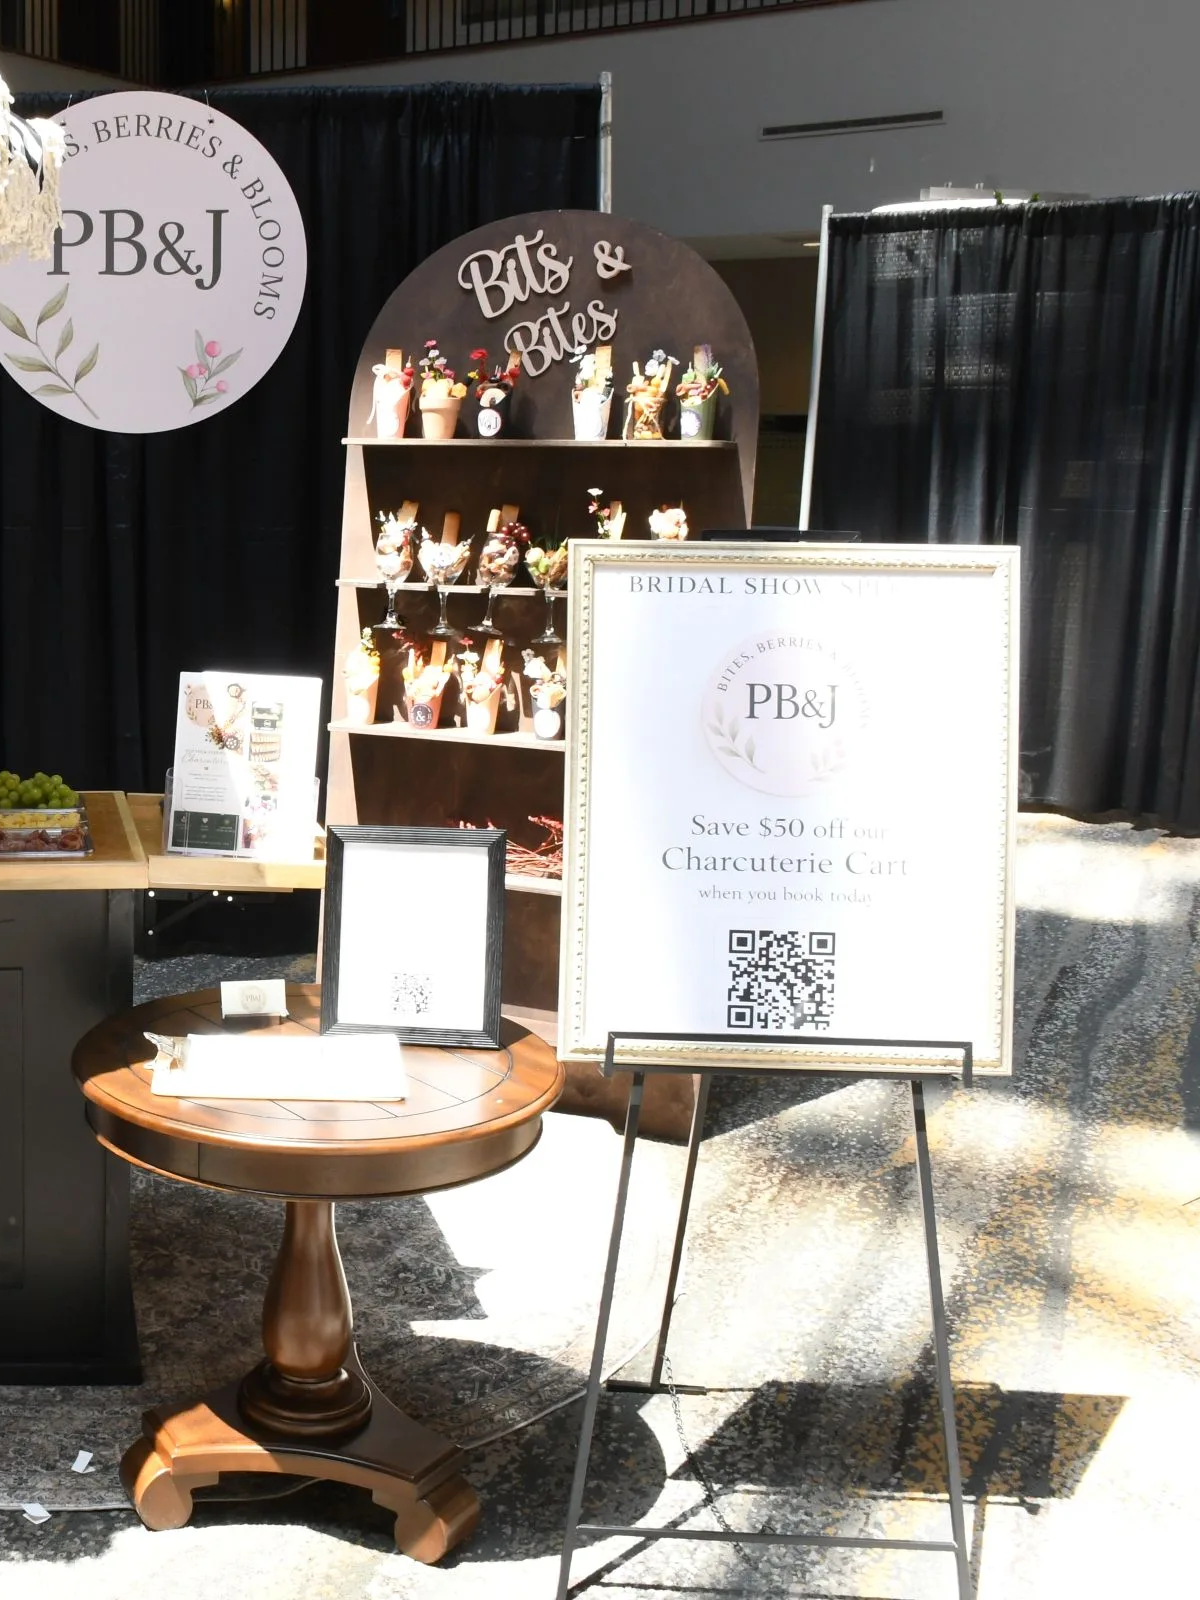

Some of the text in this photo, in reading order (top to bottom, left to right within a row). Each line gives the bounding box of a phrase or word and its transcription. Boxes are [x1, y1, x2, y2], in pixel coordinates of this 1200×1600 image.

[92, 114, 285, 321] BERRIES & BLOOMS
[46, 209, 230, 291] PB&J
[457, 229, 632, 319] Bits &
[504, 299, 619, 377] Bites
[629, 575, 733, 595] BRIDAL
[744, 577, 824, 596] SHOW
[716, 651, 755, 693] BITES,
[756, 636, 823, 654] BERRIES
[745, 682, 839, 729] PB&J
[691, 814, 889, 841] Save $50 off our
[661, 846, 909, 876] Charcuterie Cart
[698, 884, 873, 907] when you book today
